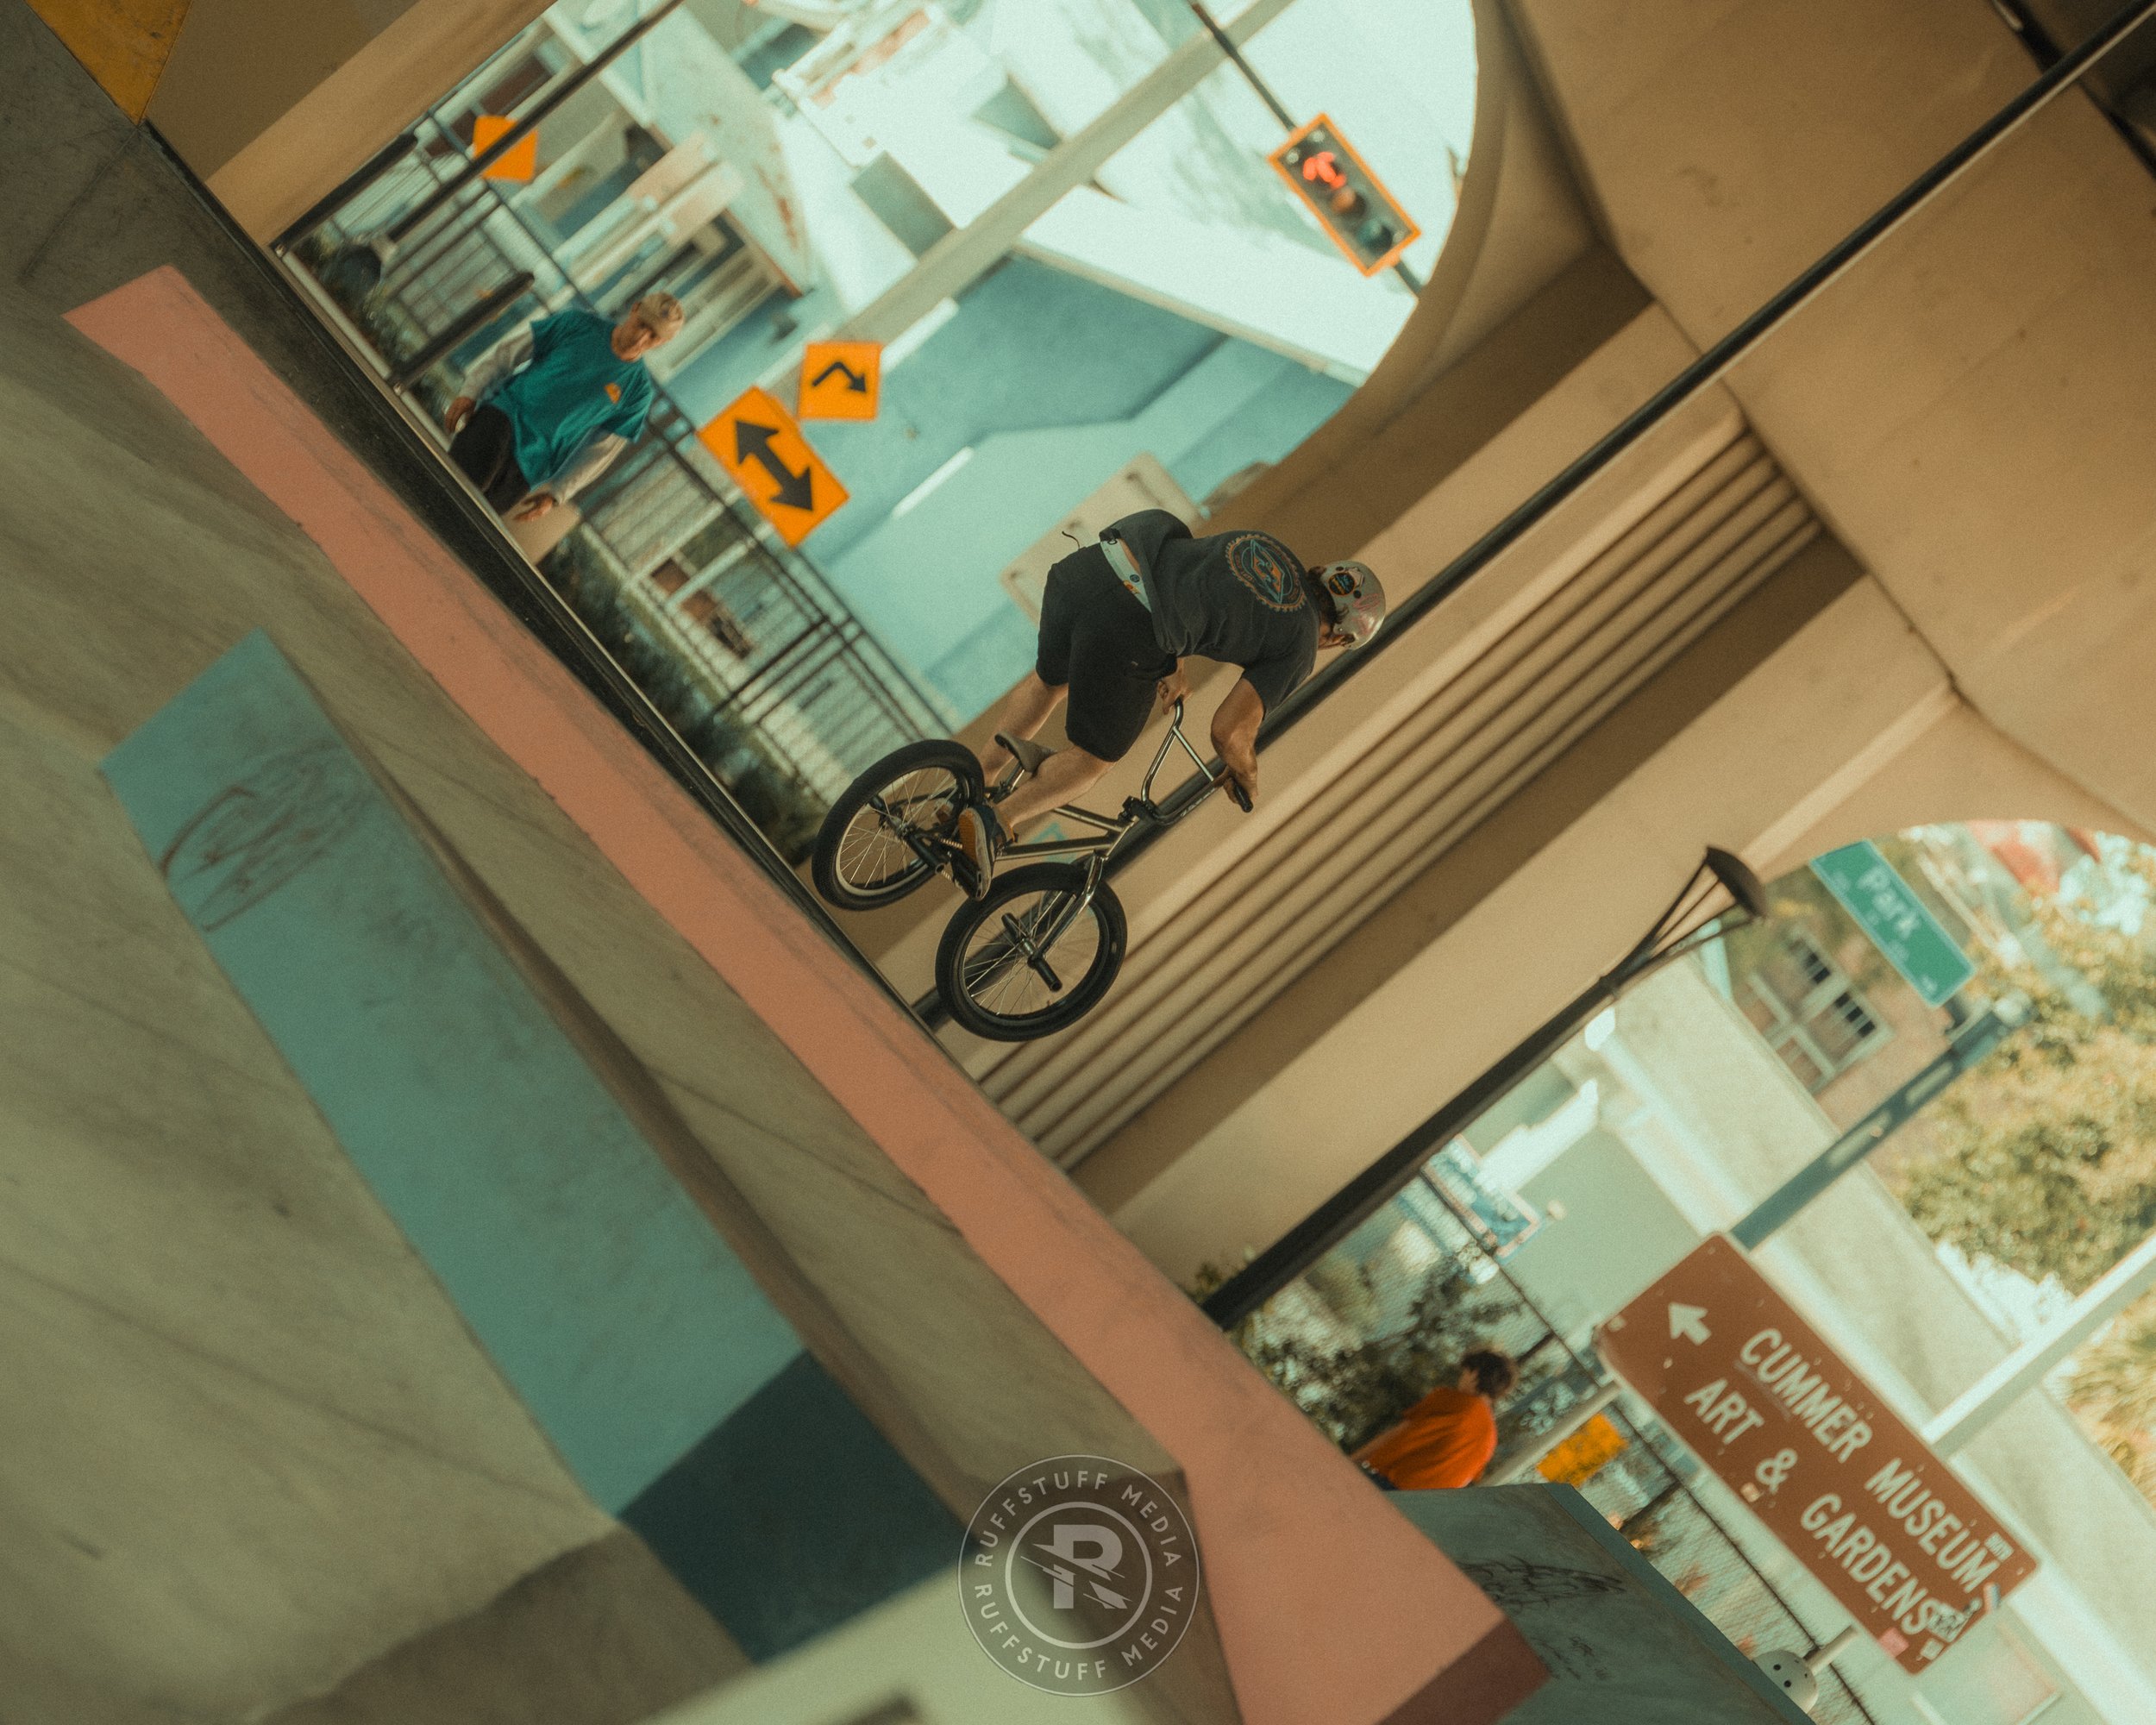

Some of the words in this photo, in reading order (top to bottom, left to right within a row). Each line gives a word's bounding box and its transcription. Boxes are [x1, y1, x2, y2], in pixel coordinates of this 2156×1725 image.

[1683, 1378, 1764, 1445] ART
[1756, 1447, 1798, 1495] &
[1799, 1492, 1943, 1635] GARDENS
[1739, 1327, 1873, 1465] CUMMER
[1864, 1458, 1999, 1594] MUSEUM
